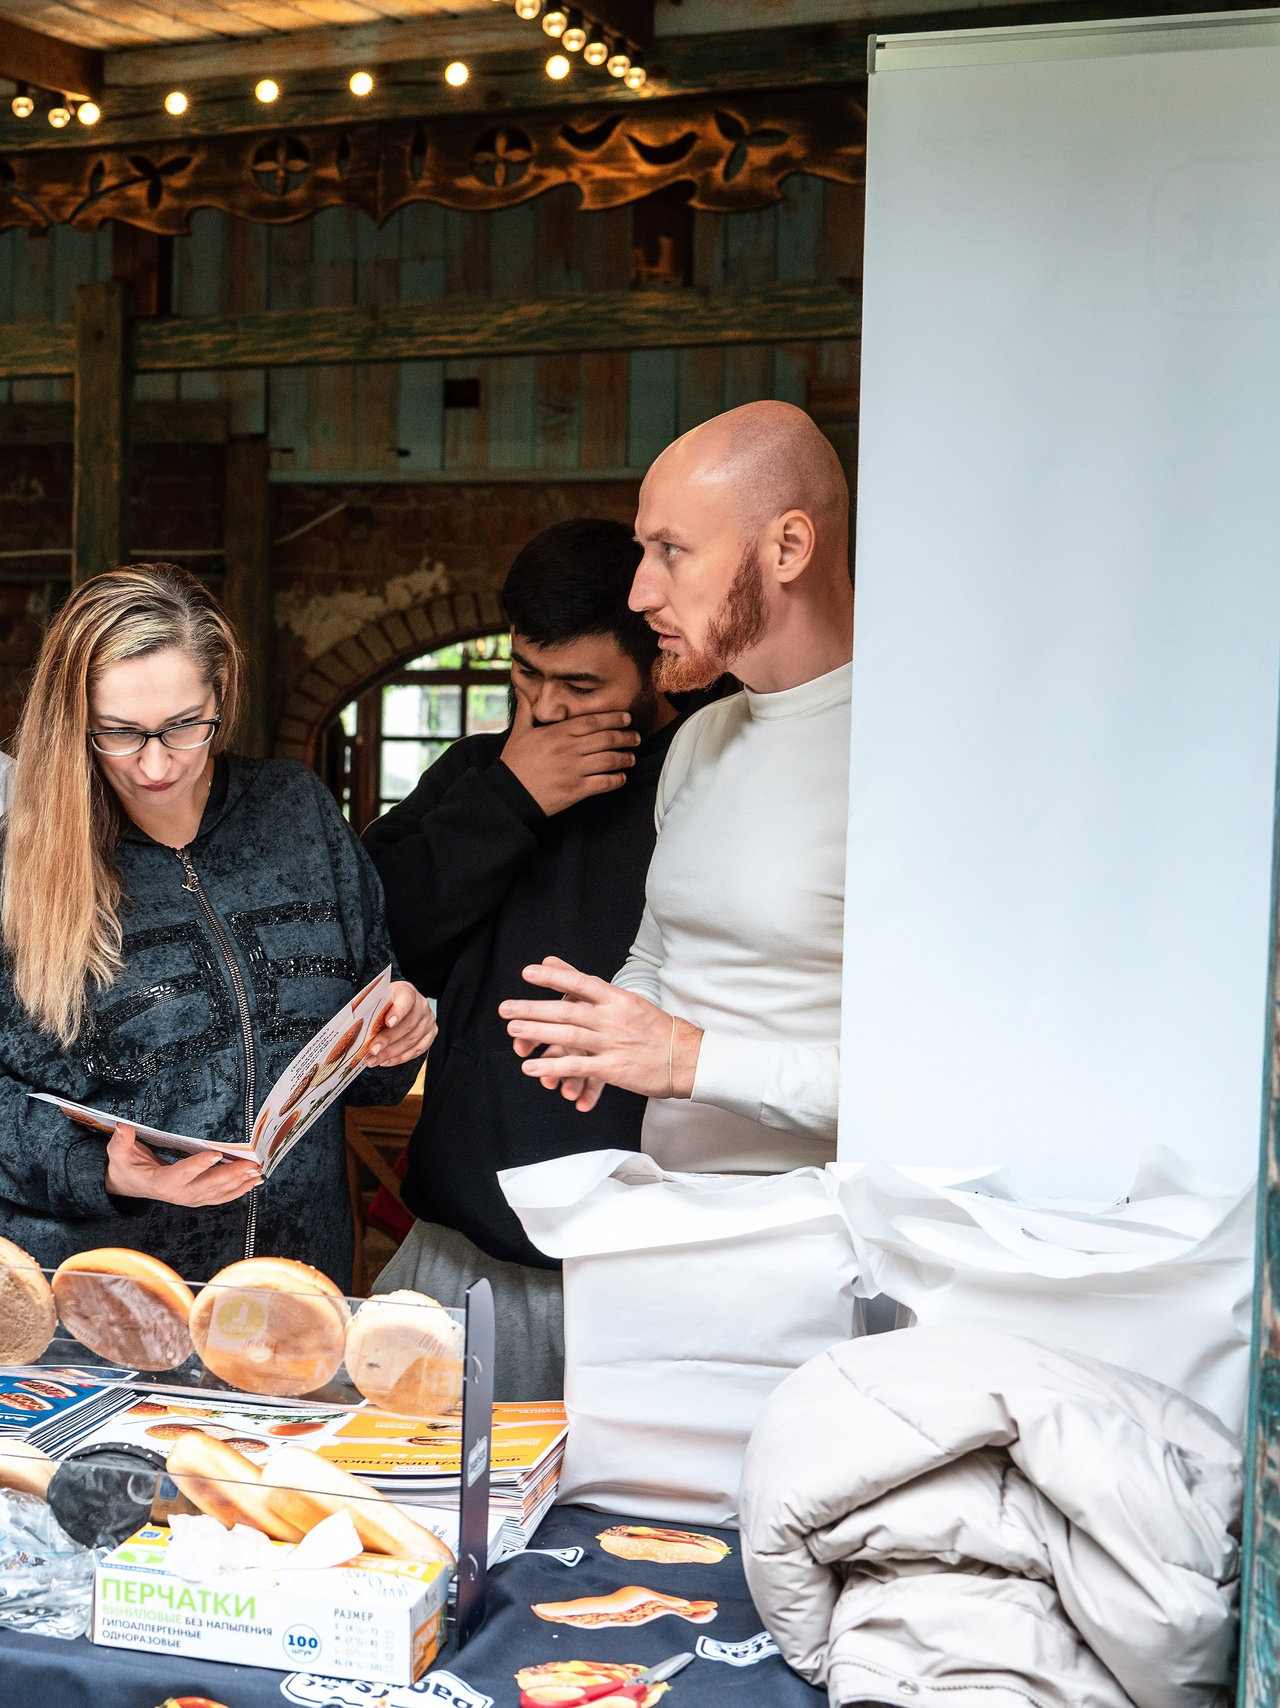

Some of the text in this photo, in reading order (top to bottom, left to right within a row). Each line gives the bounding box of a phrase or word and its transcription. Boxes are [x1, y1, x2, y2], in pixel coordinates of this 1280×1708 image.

[102, 1577, 256, 1620] ПЕРЧАТКИ
[102, 1604, 273, 1637] ВИНИЛОВЫЕ БЕЗ НАПЫЛЕНИЯ
[333, 1608, 374, 1622] РАЗМЕР
[102, 1617, 202, 1640] ГИПОАЛЛЕРГЕННЫЕ
[102, 1629, 181, 1649] ОДНОРАЗОВЫЕ
[287, 1634, 319, 1649] 100
[291, 1648, 313, 1658] штук
